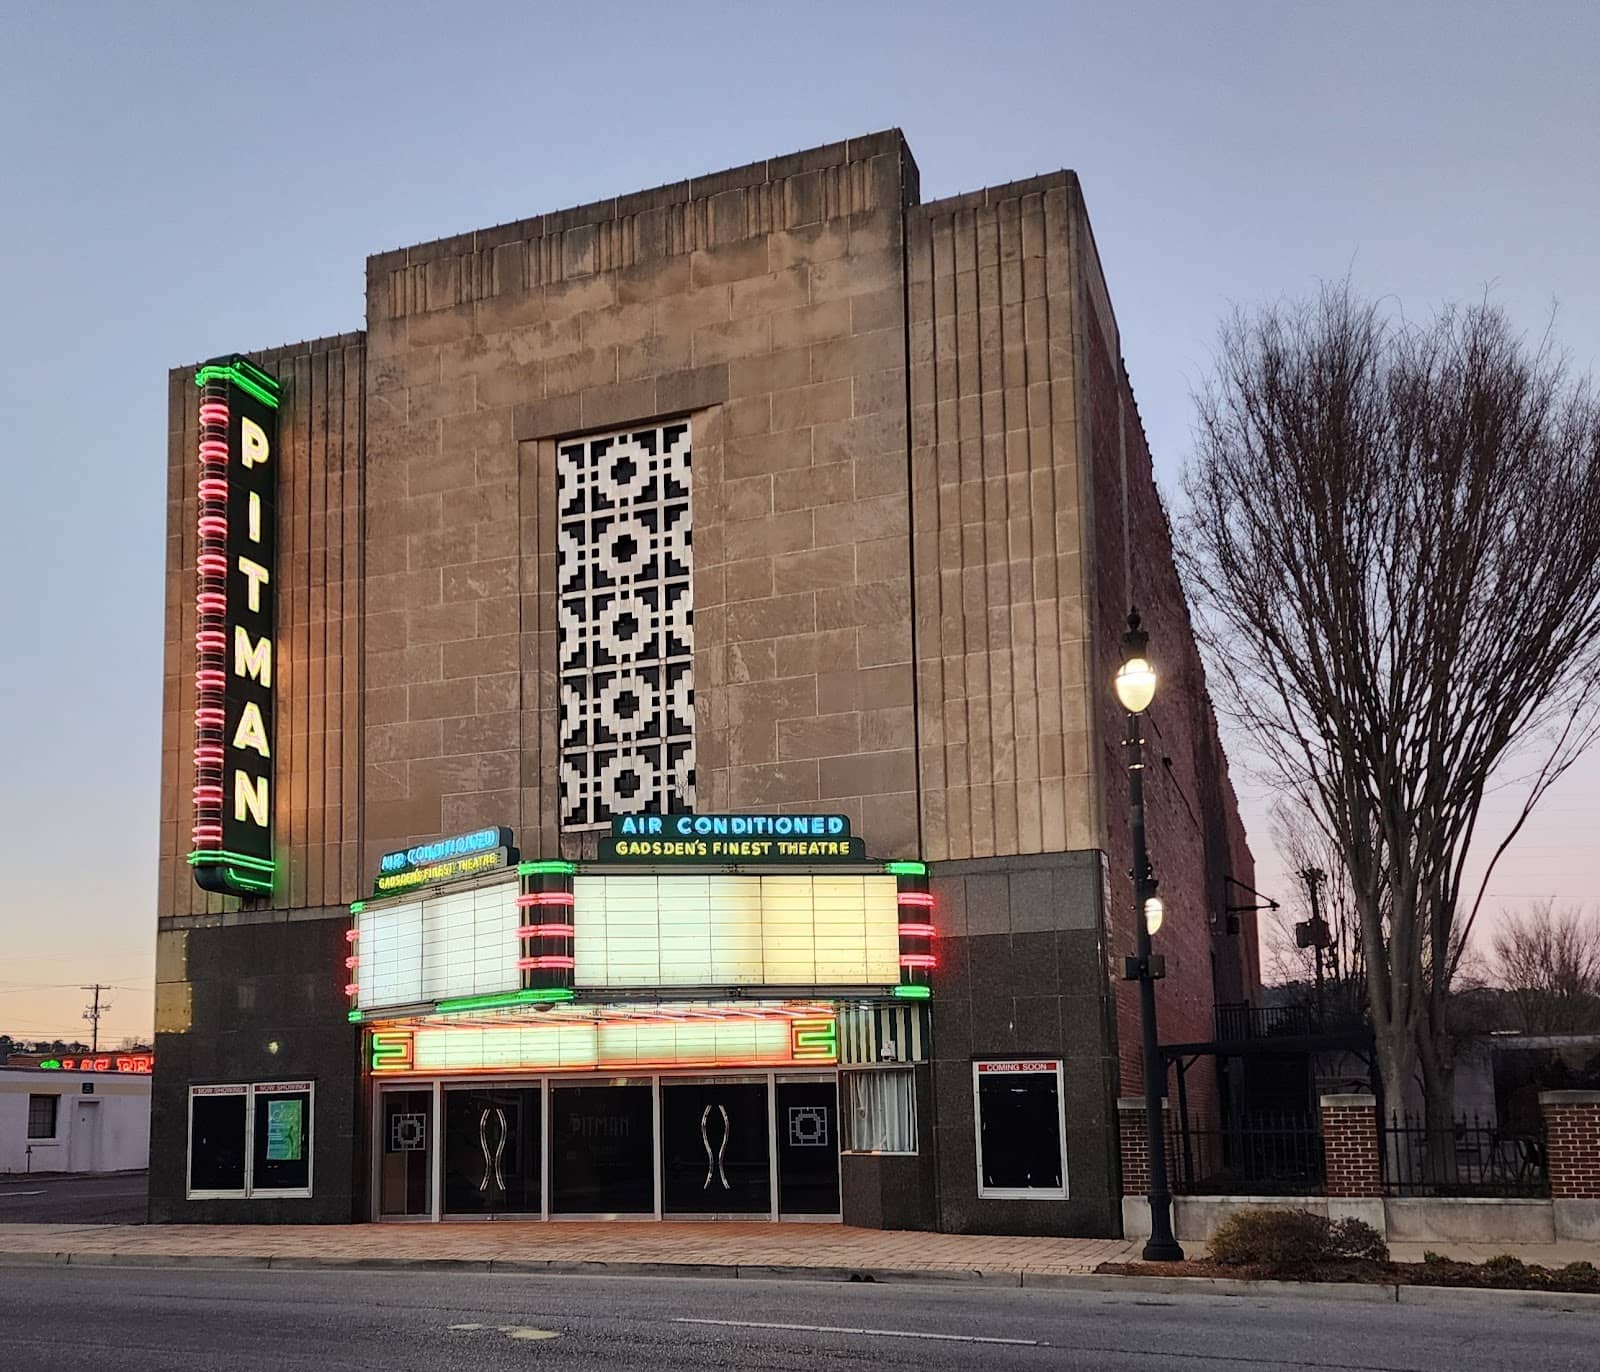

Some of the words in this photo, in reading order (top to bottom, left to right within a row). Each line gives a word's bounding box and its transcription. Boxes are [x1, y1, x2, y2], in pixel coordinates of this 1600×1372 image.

[232, 415, 273, 828] PITMAN
[621, 817, 662, 834] AIR
[676, 816, 843, 834] CONDITIONED
[381, 852, 407, 871] AIR
[407, 829, 496, 864] CONDITIONED
[615, 840, 707, 855] GADSDEN'S
[712, 841, 772, 855] FINEST
[777, 841, 850, 855] THEATRE
[423, 861, 455, 880] FINEST
[458, 852, 498, 871] THEATRE
[986, 1063, 1019, 1072] COMING
[1022, 1062, 1047, 1071] SOON
